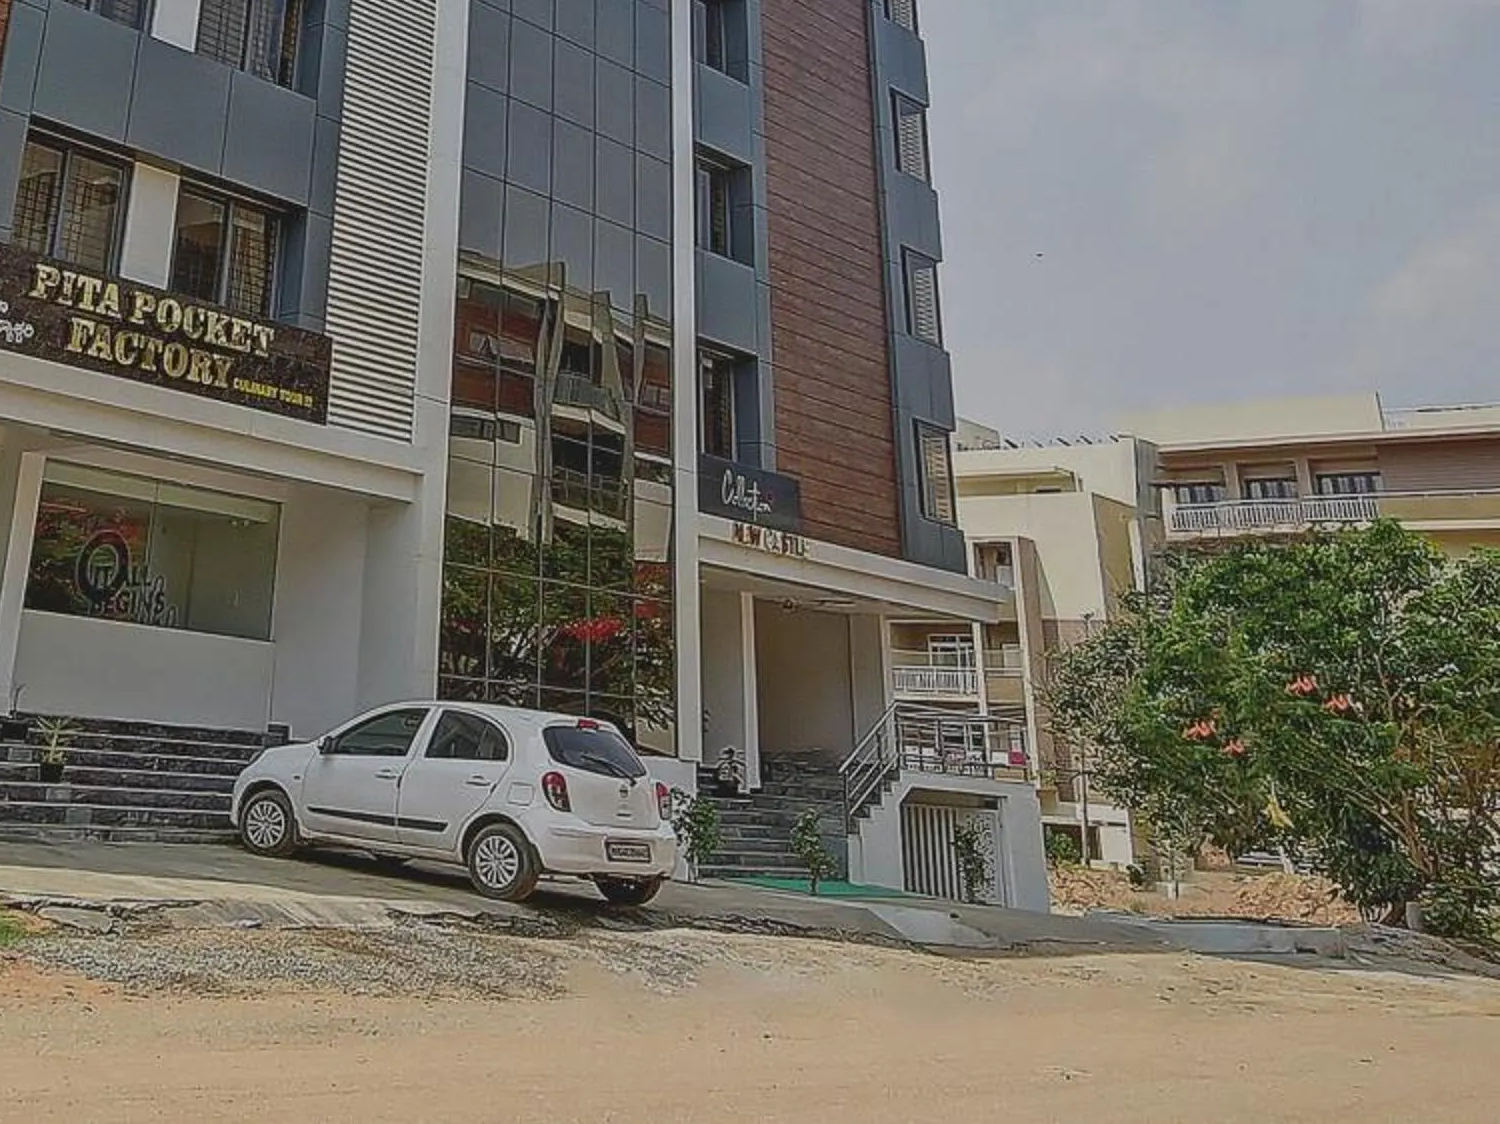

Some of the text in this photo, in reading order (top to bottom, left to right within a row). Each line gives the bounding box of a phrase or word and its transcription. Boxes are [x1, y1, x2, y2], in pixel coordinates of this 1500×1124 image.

[29, 263, 275, 358] PITA POCKET
[66, 316, 235, 390] FACTORY
